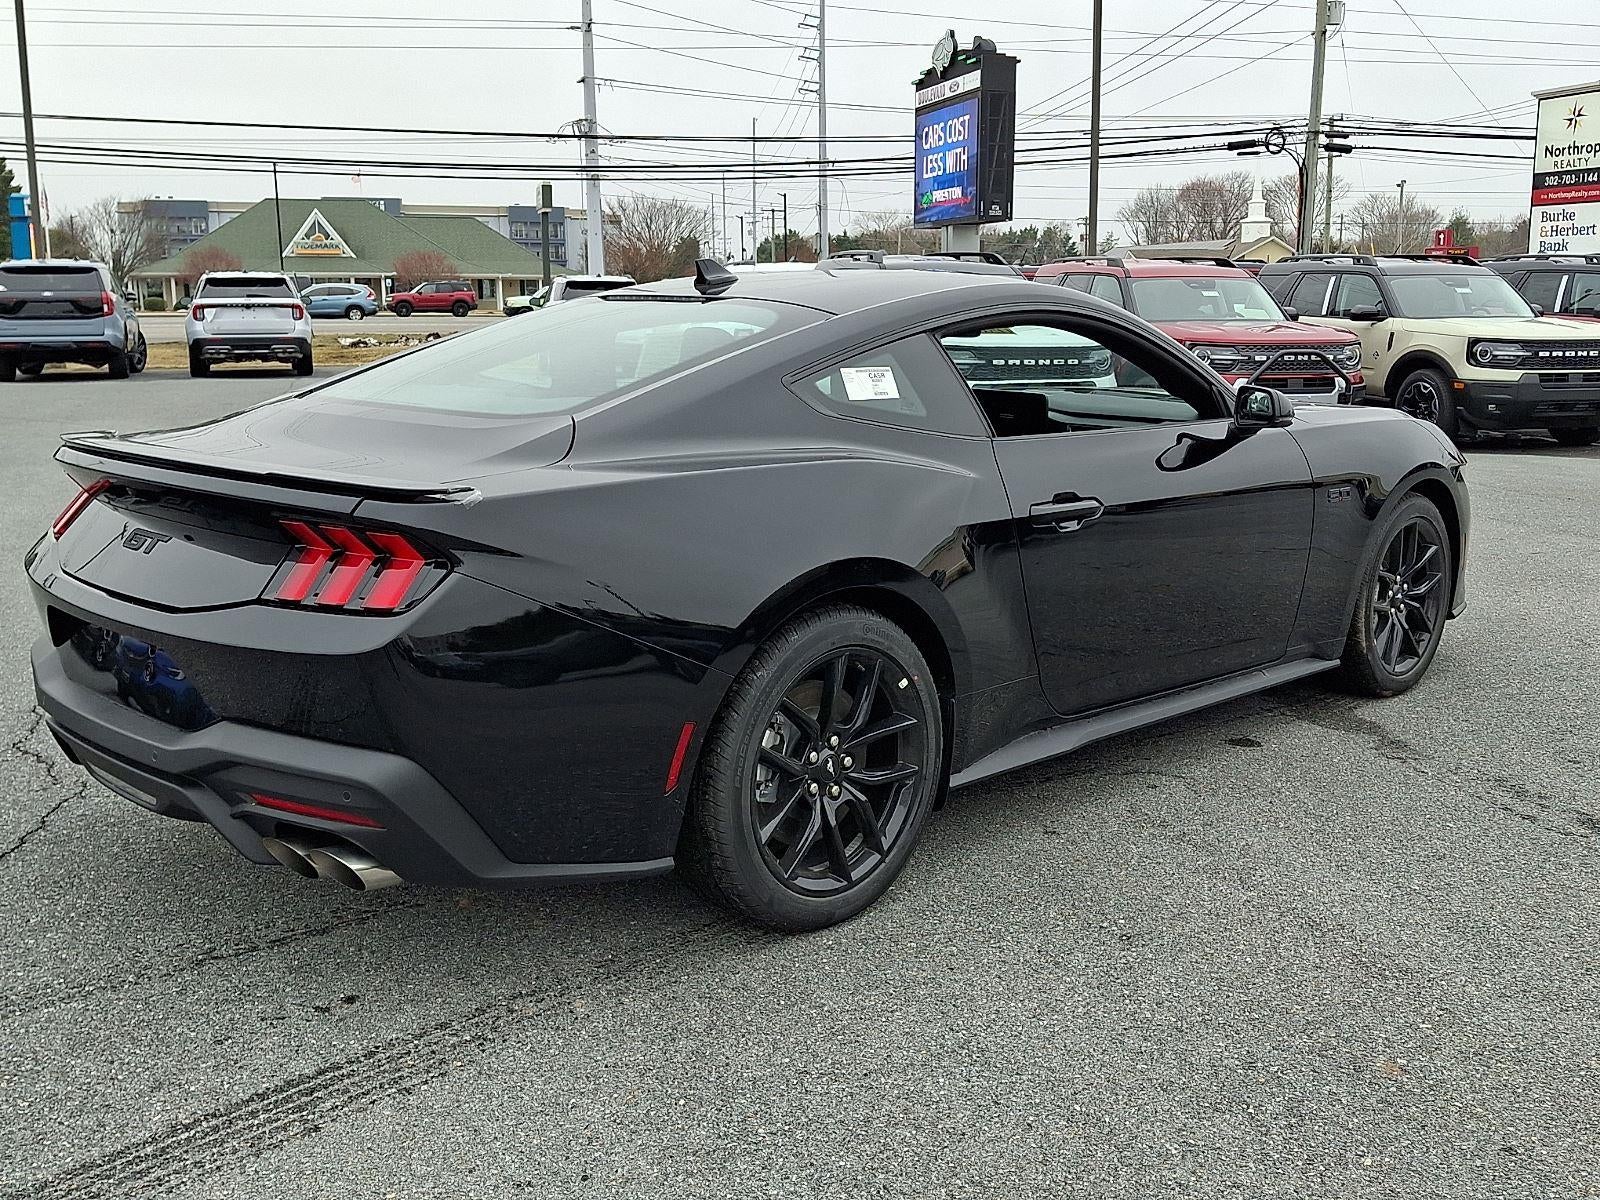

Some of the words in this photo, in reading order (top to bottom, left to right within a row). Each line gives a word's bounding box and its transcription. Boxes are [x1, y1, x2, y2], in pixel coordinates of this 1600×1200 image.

[923, 122, 945, 150] CARS
[946, 114, 970, 143] COST
[1544, 140, 1600, 158] Northrop
[923, 152, 944, 178] LESS
[946, 146, 967, 174] WITH
[1553, 157, 1591, 170] REALTY
[1544, 172, 1598, 186] 302-703-1144
[932, 186, 963, 203] PRESTON
[1540, 208, 1576, 223] Burke
[1539, 239, 1569, 252] Bank
[123, 527, 173, 555] GT
